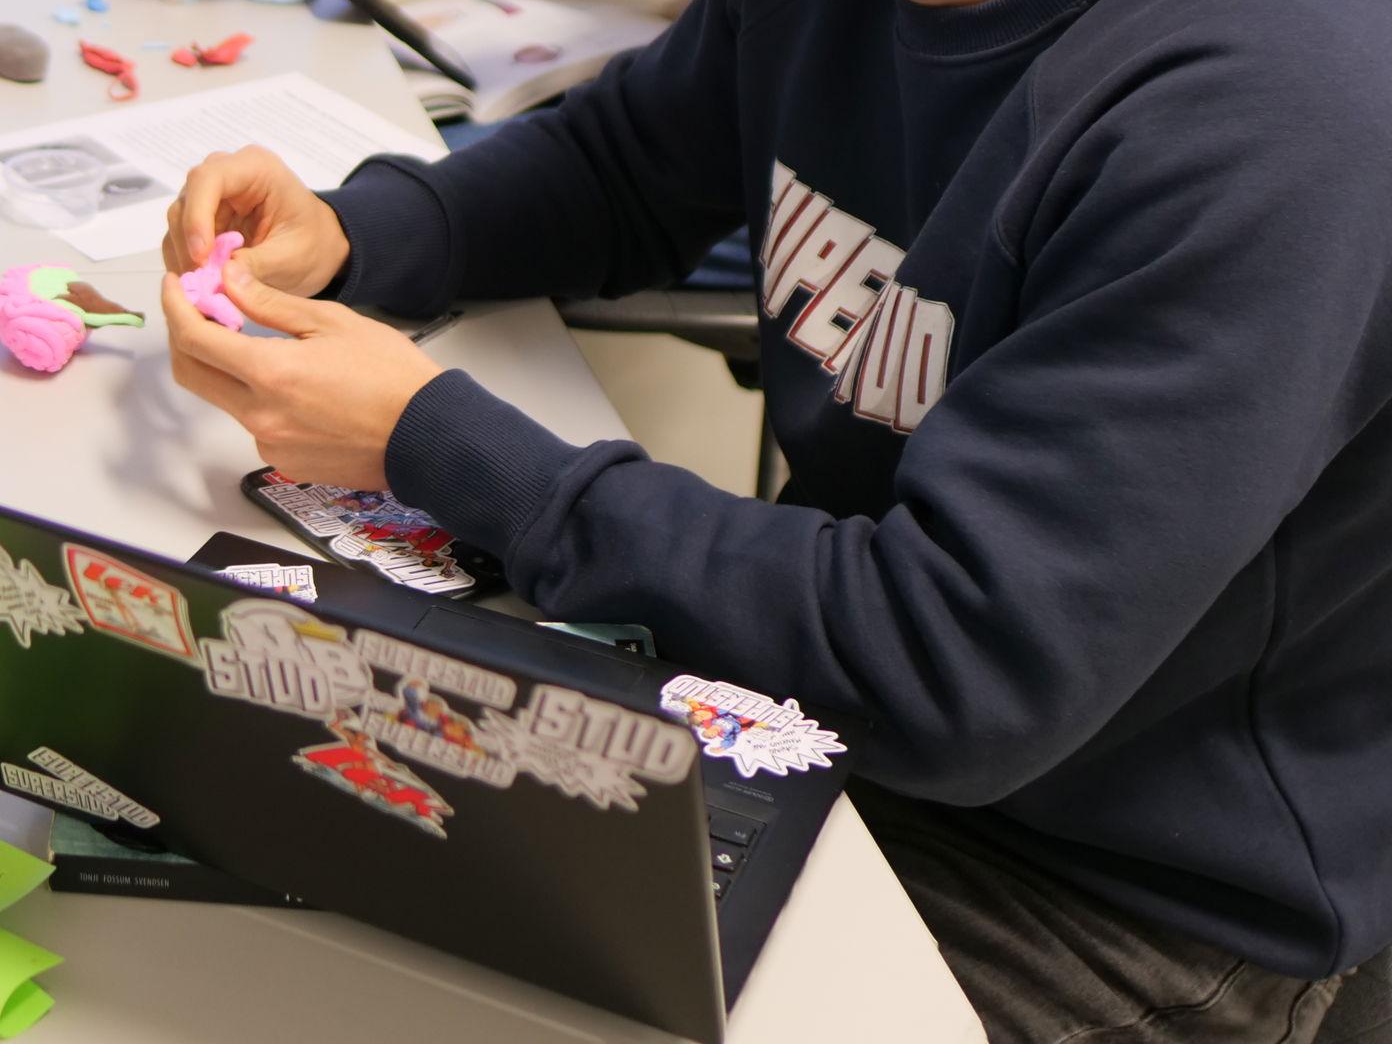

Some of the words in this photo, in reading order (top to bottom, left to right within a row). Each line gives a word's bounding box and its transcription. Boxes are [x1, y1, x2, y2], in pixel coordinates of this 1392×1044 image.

[204, 640, 335, 716] STUD
[666, 678, 801, 733] SUPERSTUD
[530, 689, 694, 779] STUD
[31, 749, 158, 824] SUPERSTUD
